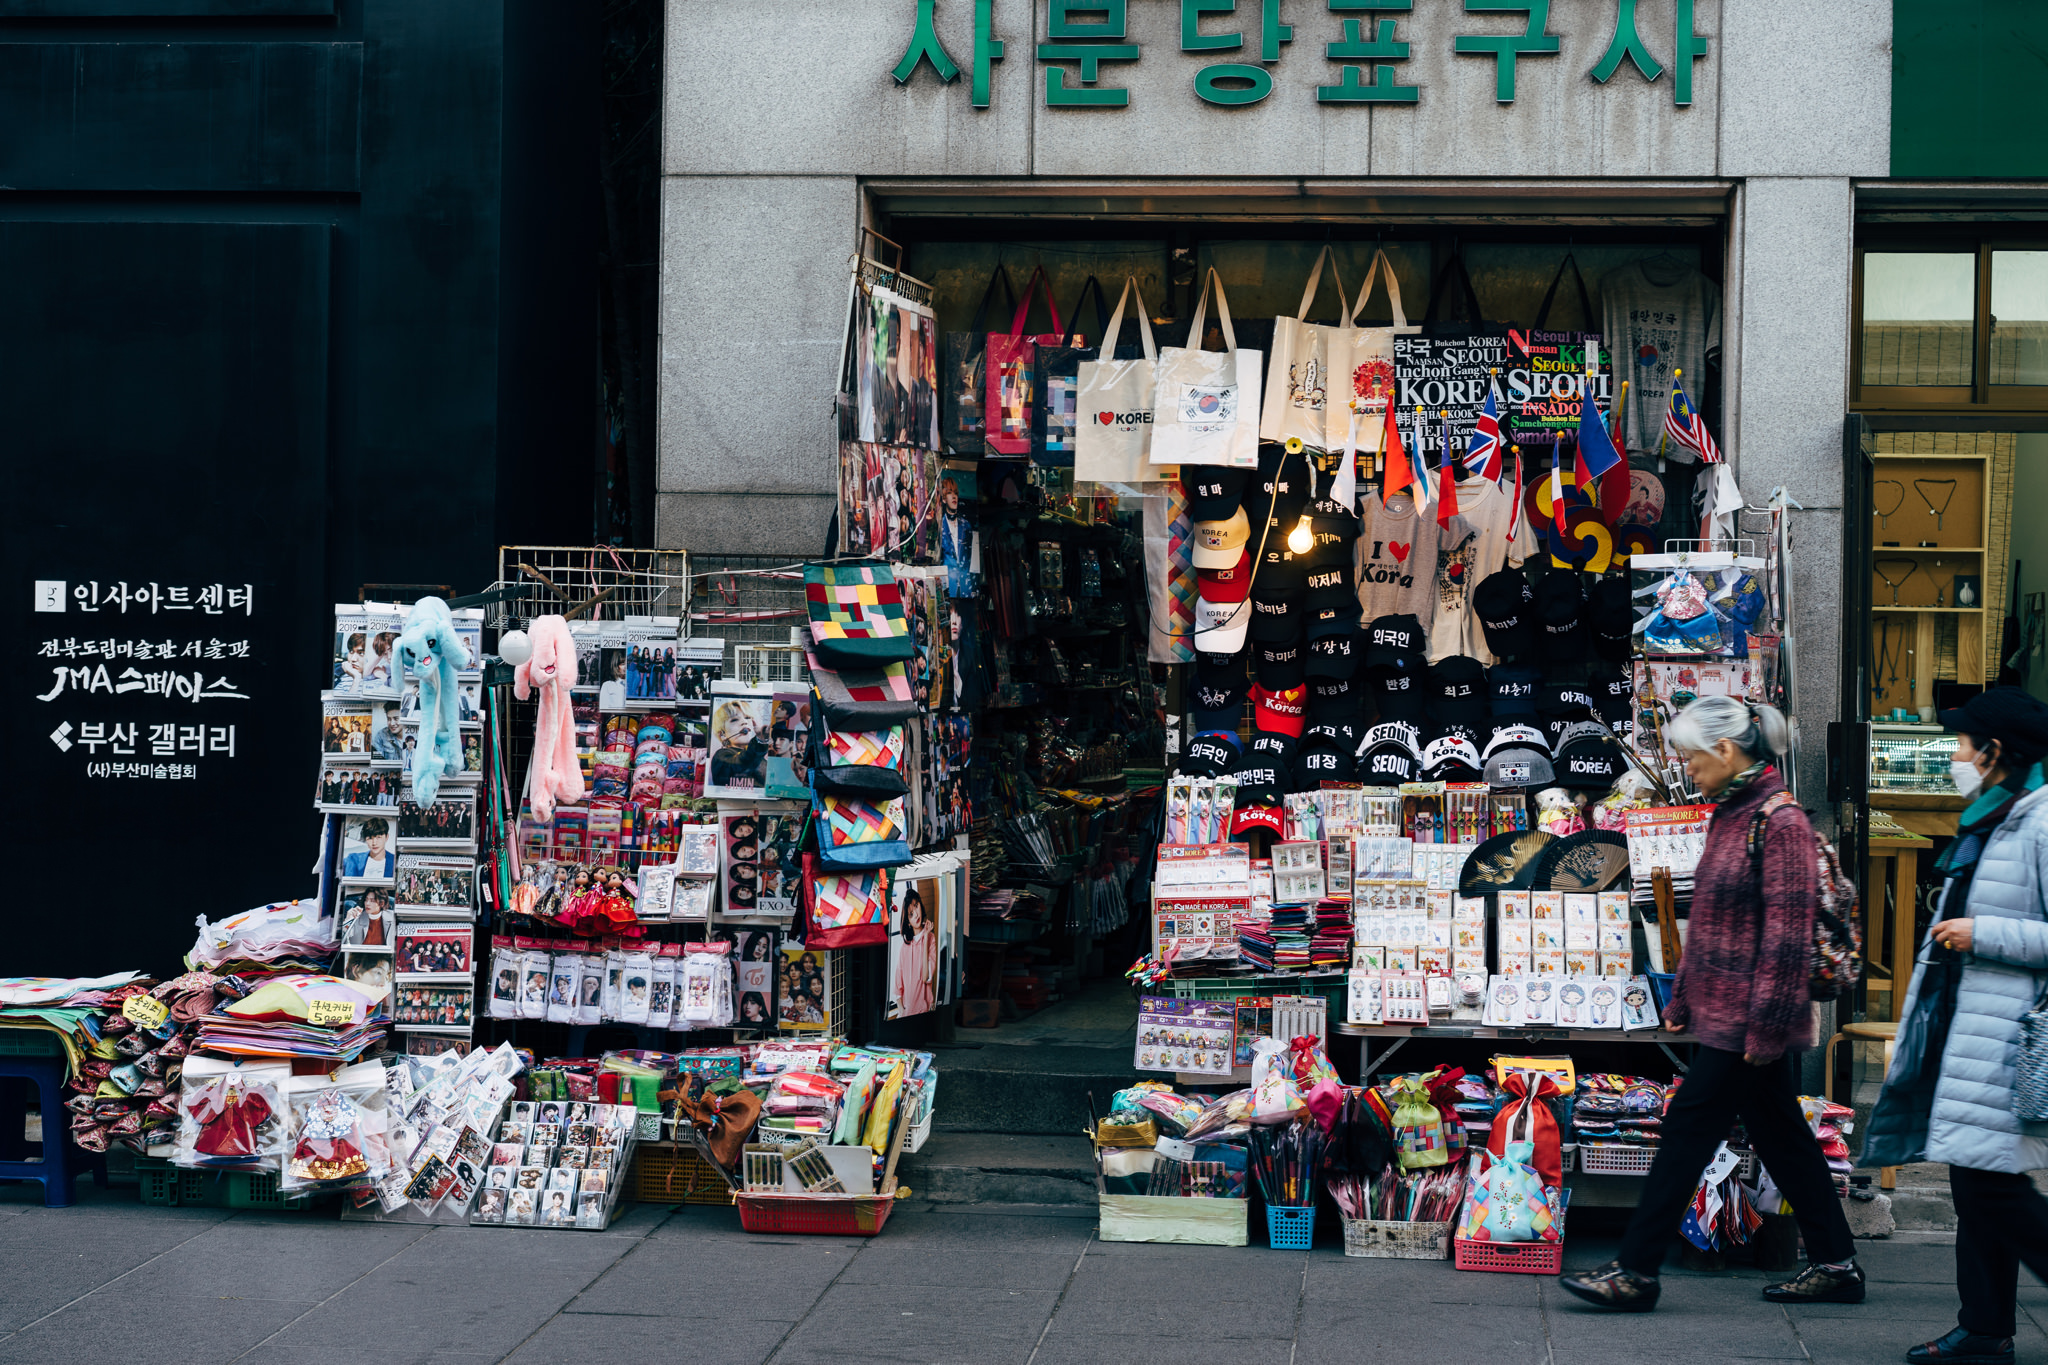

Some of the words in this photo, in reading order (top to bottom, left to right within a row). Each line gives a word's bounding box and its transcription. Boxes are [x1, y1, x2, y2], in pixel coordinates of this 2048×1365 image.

[1630, 310, 1677, 325] 대한민국
[1394, 339, 1432, 358] 한국
[1468, 336, 1507, 348] KOREA
[1443, 348, 1507, 368] SEOUL
[1532, 356, 1579, 372] SEOUL
[1395, 364, 1451, 378] Inchon
[1398, 376, 1507, 406] KOREA
[1508, 368, 1612, 404] SEOUL
[1429, 410, 1475, 419] HAKOOK
[1521, 402, 1588, 416] INSADO
[1453, 426, 1476, 435] Kore
[1198, 483, 1223, 496] 엄마
[1263, 481, 1290, 494] 아빠
[1201, 528, 1228, 538] KOREA
[1371, 541, 1383, 559] I
[1308, 571, 1342, 589] 아저씨
[73, 580, 253, 617] 인사아트센터
[1206, 610, 1234, 619] KOREA
[338, 623, 358, 632] 2019
[370, 621, 389, 631] 2019
[603, 639, 620, 648] 2019
[629, 633, 647, 642] 2019
[1373, 629, 1410, 648] 외국인
[37, 637, 177, 660] 전북도립미술관
[180, 638, 250, 659] 서울관
[576, 642, 593, 650] 2019
[1311, 641, 1350, 655] 사장님
[36, 663, 251, 703] JMA스페이스
[1386, 676, 1411, 691] 반장
[1499, 682, 1532, 697] 사춘기
[1444, 684, 1472, 698] 최고
[325, 707, 344, 716] 2019
[1265, 697, 1302, 714] Korea
[404, 726, 419, 735] 201
[1371, 725, 1410, 747] SEOUL
[77, 721, 139, 755] 부산
[148, 723, 236, 758] 갤러리
[1253, 737, 1285, 754] 대박
[1189, 743, 1228, 766] 외국인
[1431, 746, 1471, 760] Korea
[1306, 754, 1338, 769] 대장
[1371, 754, 1410, 779] SEOUL
[1570, 760, 1613, 775] KOREA
[86, 762, 196, 780] (사)부산미술협회
[1233, 768, 1275, 788] 대한민국
[726, 777, 754, 788] JIMIN
[401, 792, 415, 800] 201
[1239, 811, 1280, 826] Korea
[1672, 810, 1699, 821] KOREA
[759, 901, 784, 911] EXO
[399, 927, 416, 936] 2019
